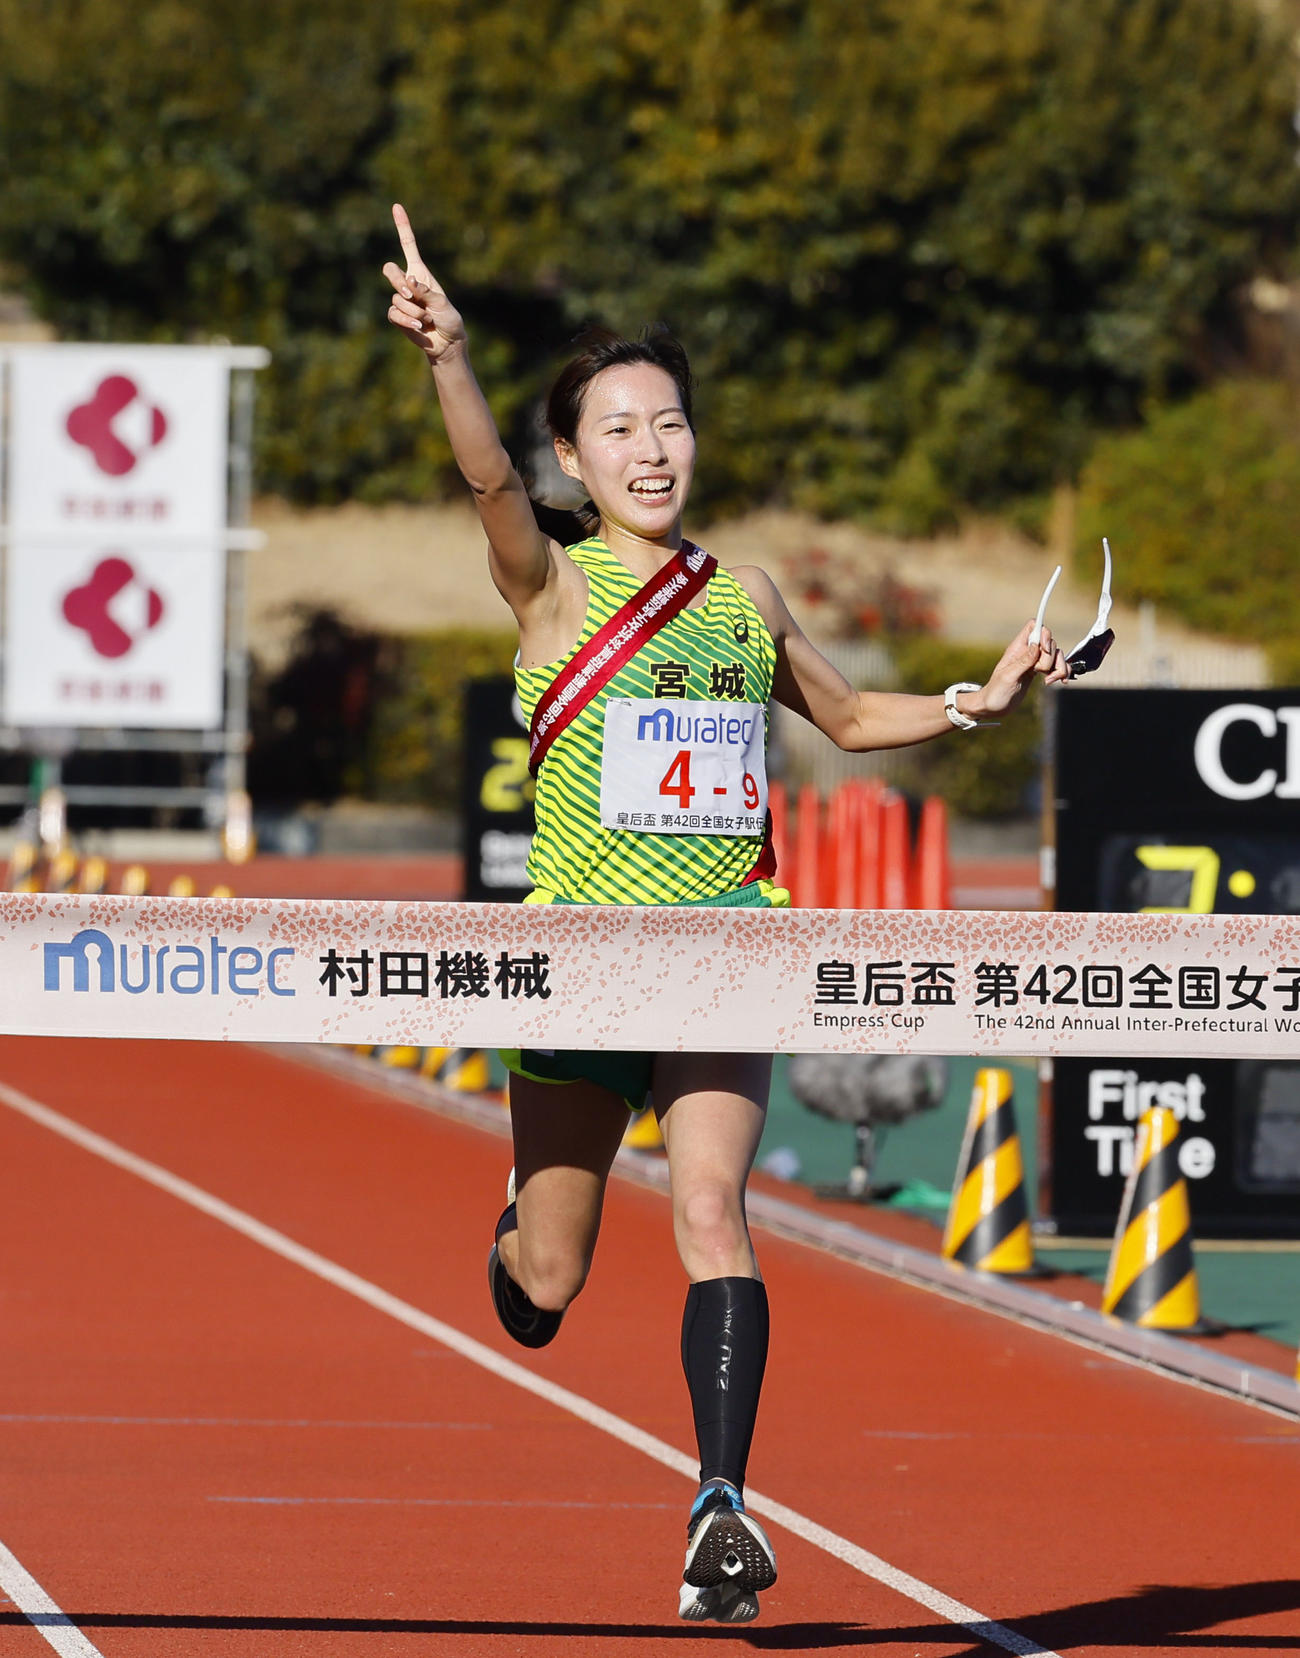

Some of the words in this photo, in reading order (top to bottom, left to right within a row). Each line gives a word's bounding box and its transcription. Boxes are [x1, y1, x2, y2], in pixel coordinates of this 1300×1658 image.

[616, 812, 656, 827] 皇后盃
[319, 948, 552, 1000] 村田機械
[814, 960, 956, 1006] 皇后盃
[974, 961, 1300, 1012] 第42回全国女子
[891, 1014, 925, 1031] Cup
[975, 1014, 1007, 1029] The
[1014, 1015, 1055, 1029] 42nd
[1061, 1016, 1121, 1031] Annual
[1127, 1016, 1268, 1033] Inter-Prefectural
[1088, 1069, 1206, 1122] First
[1083, 1125, 1216, 1179] Tie
